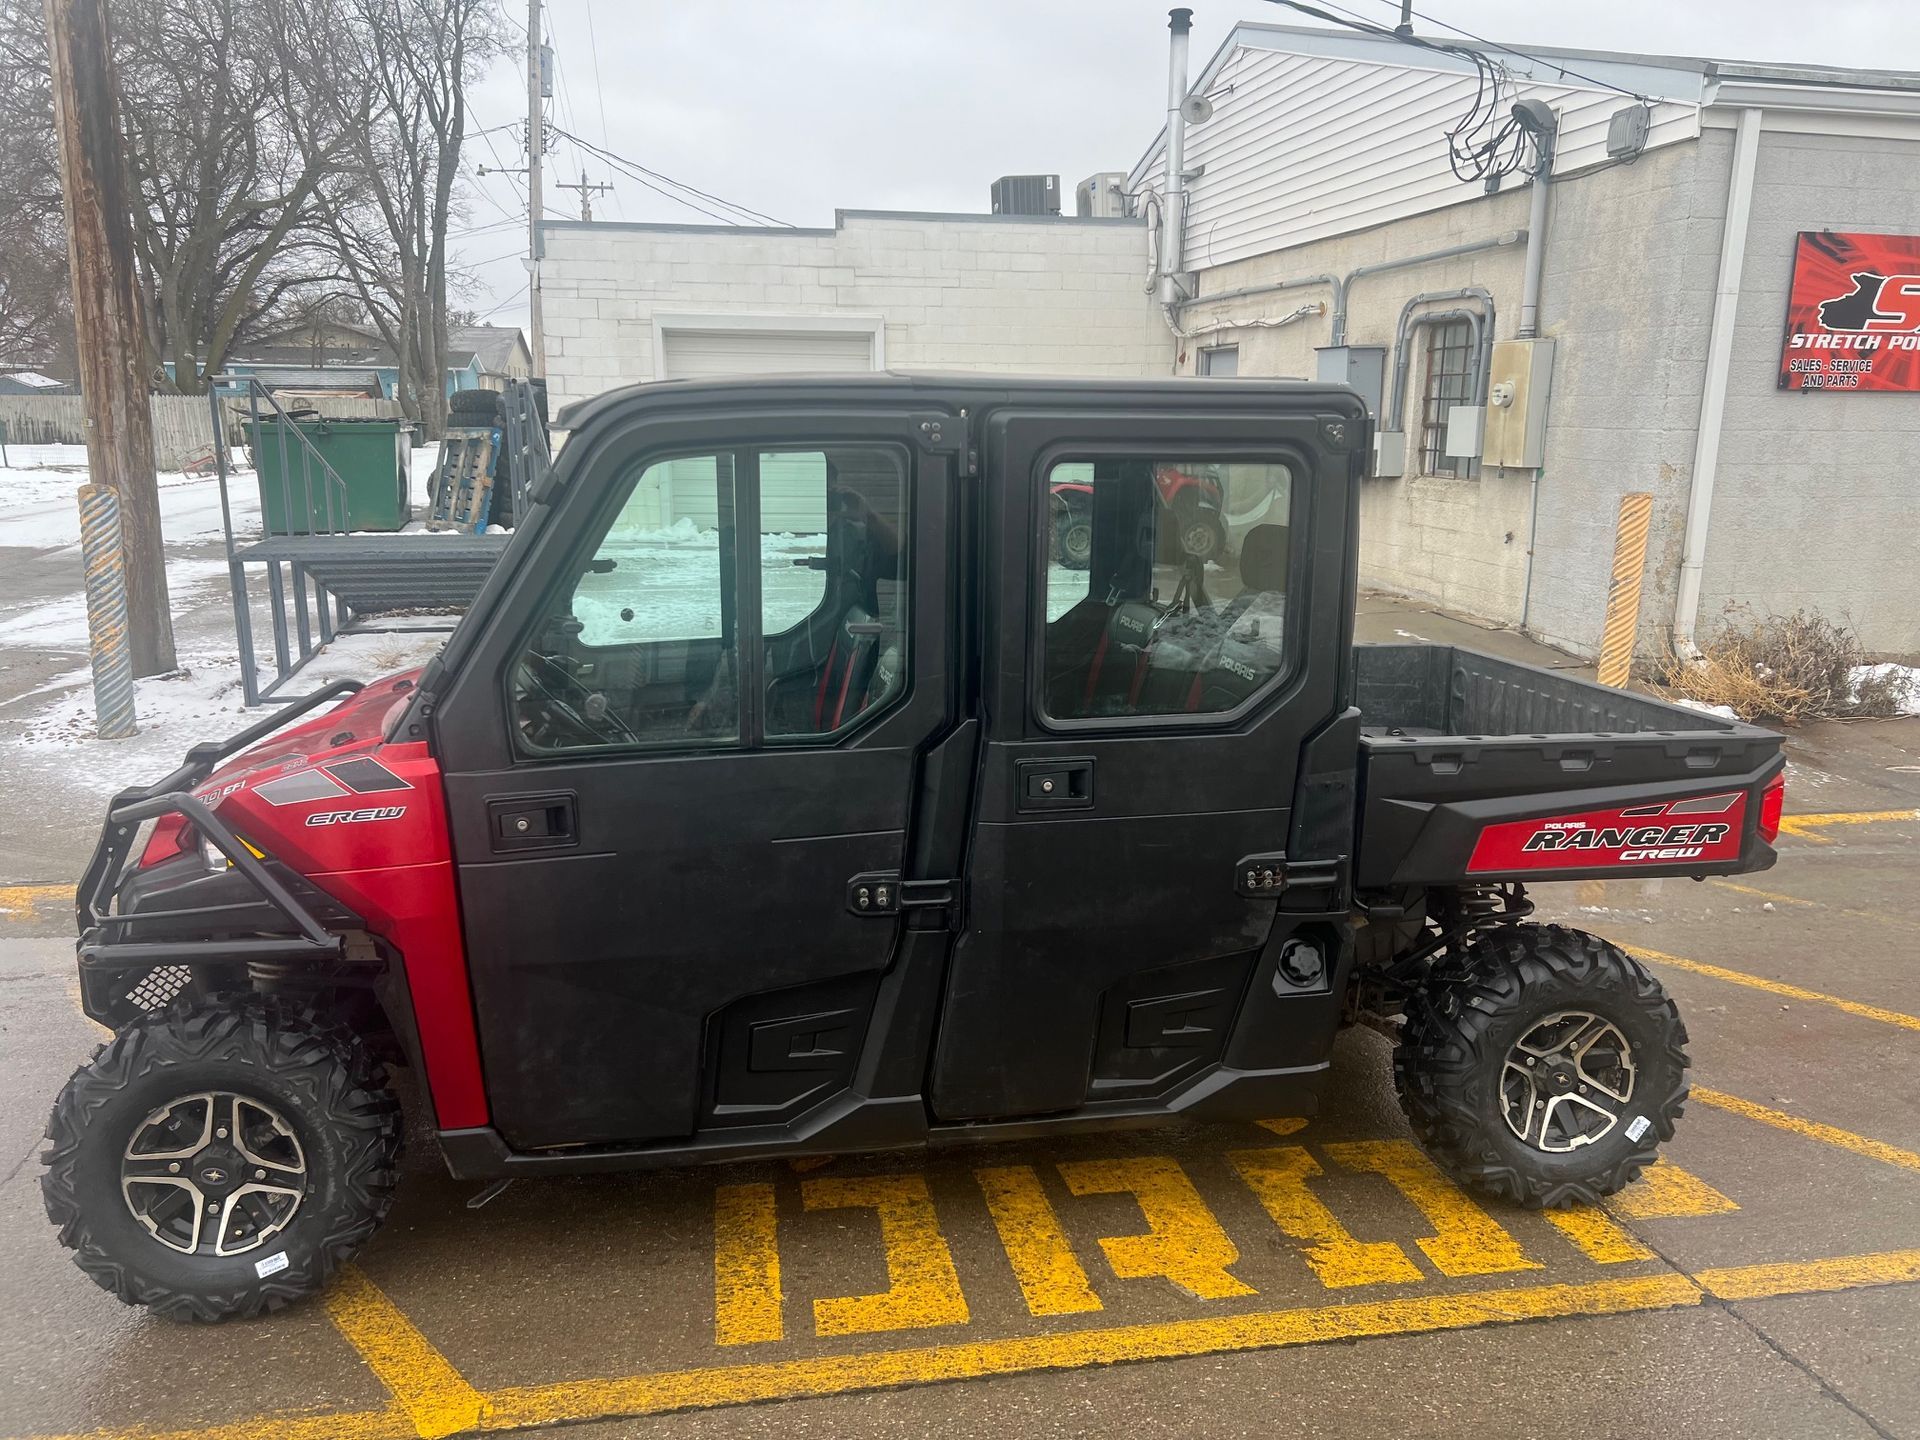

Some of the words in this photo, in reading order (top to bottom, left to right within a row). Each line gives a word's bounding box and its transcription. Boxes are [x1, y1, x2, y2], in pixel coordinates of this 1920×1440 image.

[1790, 333, 1882, 350] STRETCH
[1790, 359, 1822, 373] SALES
[1829, 359, 1873, 374] SERVICE
[1801, 374, 1824, 387] AND
[1825, 374, 1858, 388] PARTS
[1119, 615, 1145, 633] POLARIS
[1219, 655, 1256, 681] POLARIS
[222, 780, 246, 796] EFI
[305, 806, 407, 827] CREW
[1544, 821, 1586, 830] POLARIS
[1521, 823, 1730, 852] RANGER
[1618, 847, 1704, 861] CREW
